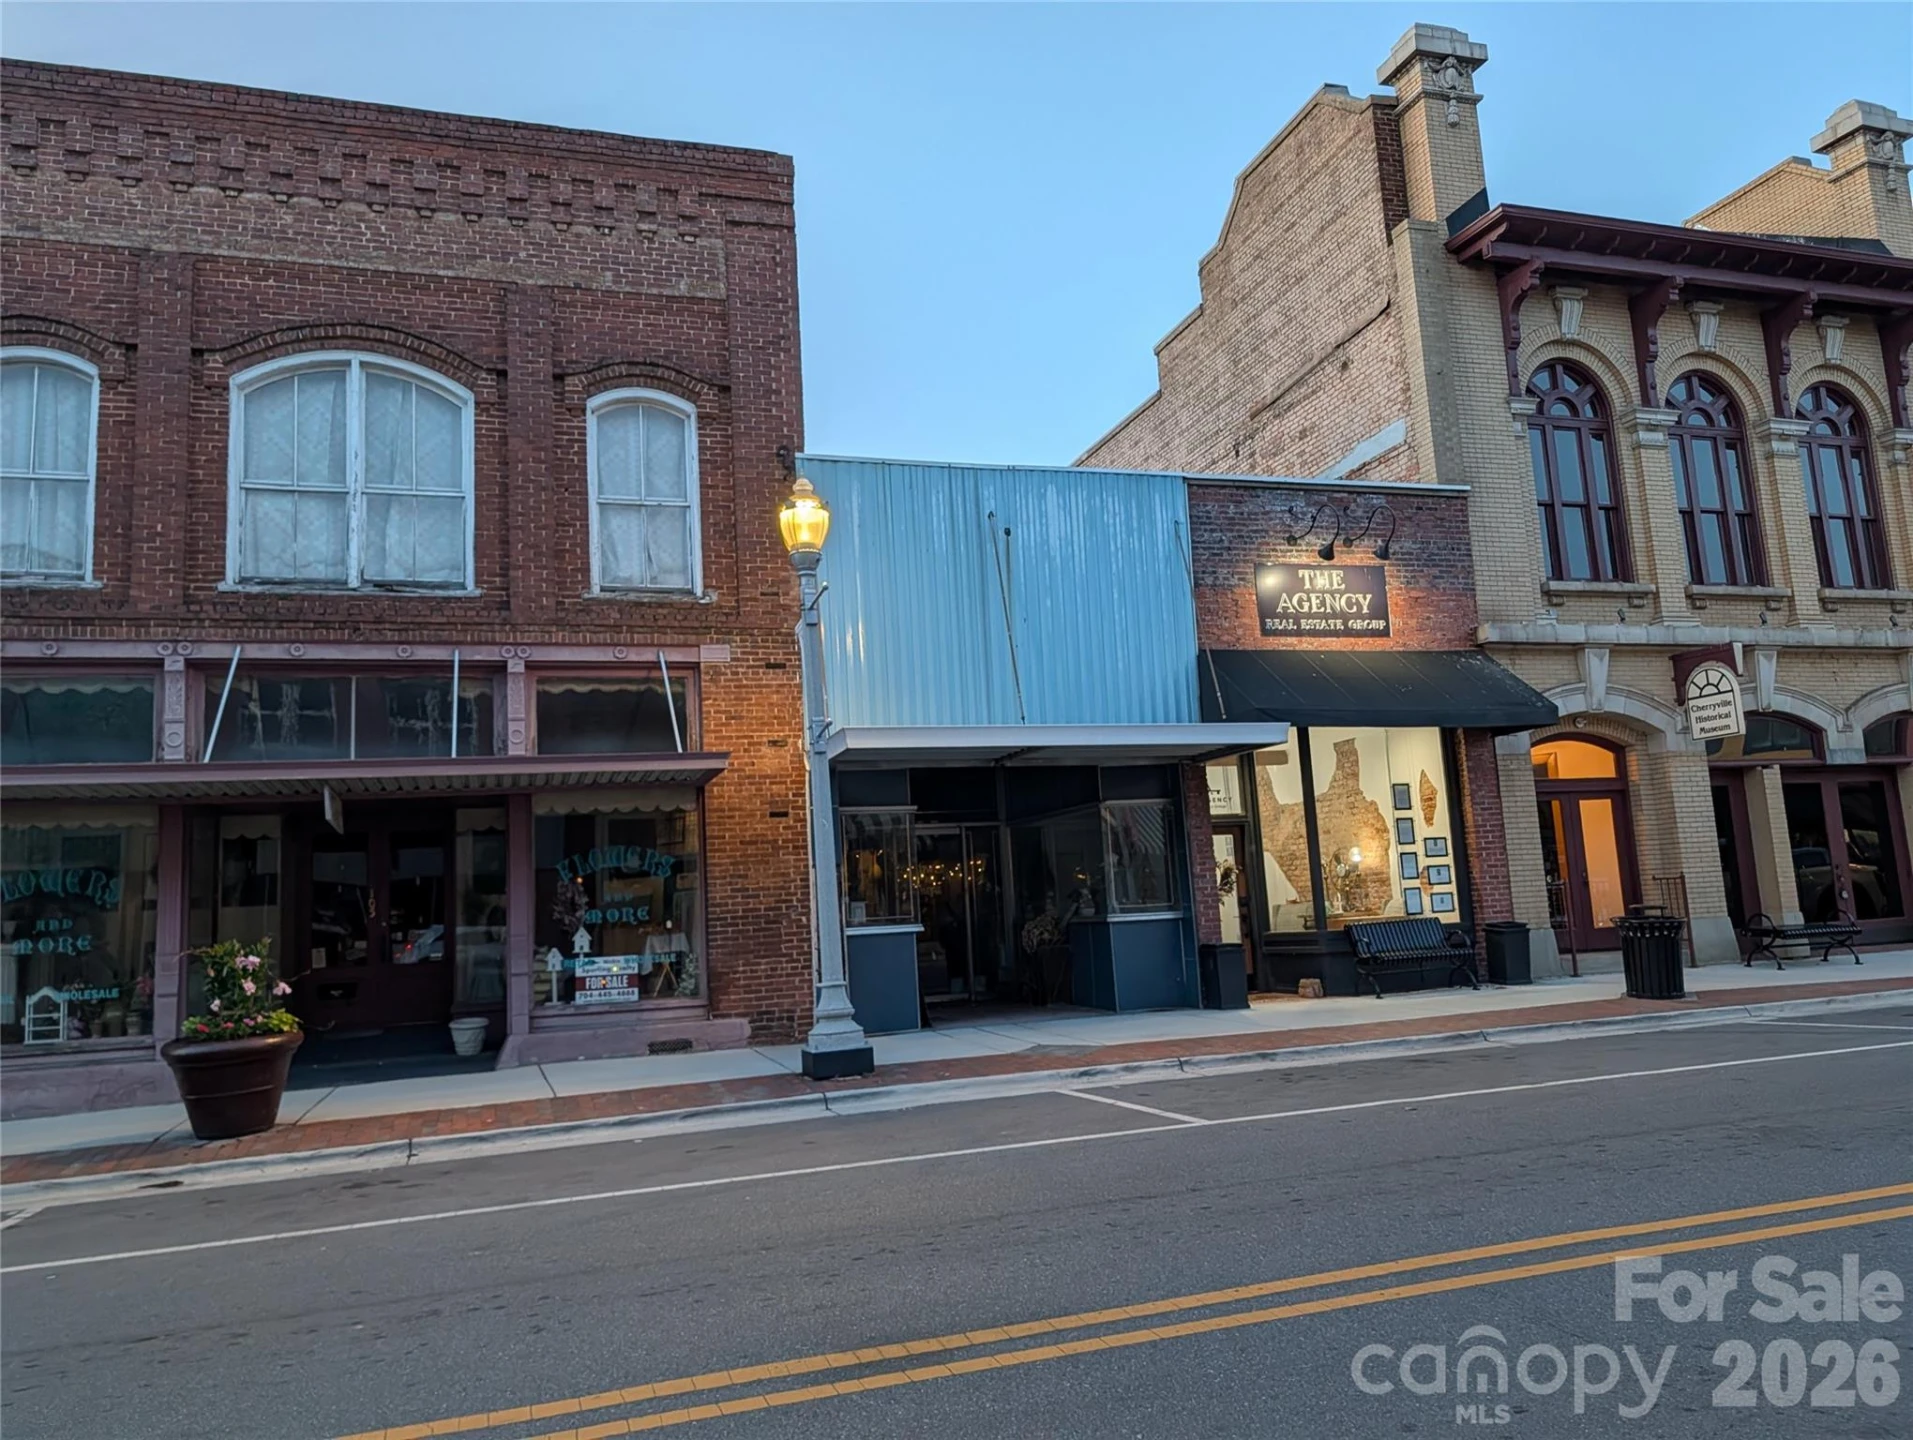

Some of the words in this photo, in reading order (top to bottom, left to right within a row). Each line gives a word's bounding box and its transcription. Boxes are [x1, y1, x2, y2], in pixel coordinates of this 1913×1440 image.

[1298, 569, 1345, 590] THE
[1276, 593, 1372, 614] AGENCY
[1265, 618, 1297, 630] REAL
[1300, 619, 1344, 631] ESTATE
[1348, 619, 1386, 631] GROUP
[1691, 700, 1732, 713] Cherryville
[1695, 711, 1732, 724] Historical
[1699, 724, 1731, 735] Museum
[555, 845, 677, 884] FLOWERS
[0, 868, 120, 908] LOWERS
[584, 906, 650, 926] MORE
[32, 917, 73, 934] AND
[12, 935, 92, 956] MORE
[604, 974, 628, 988] SALE
